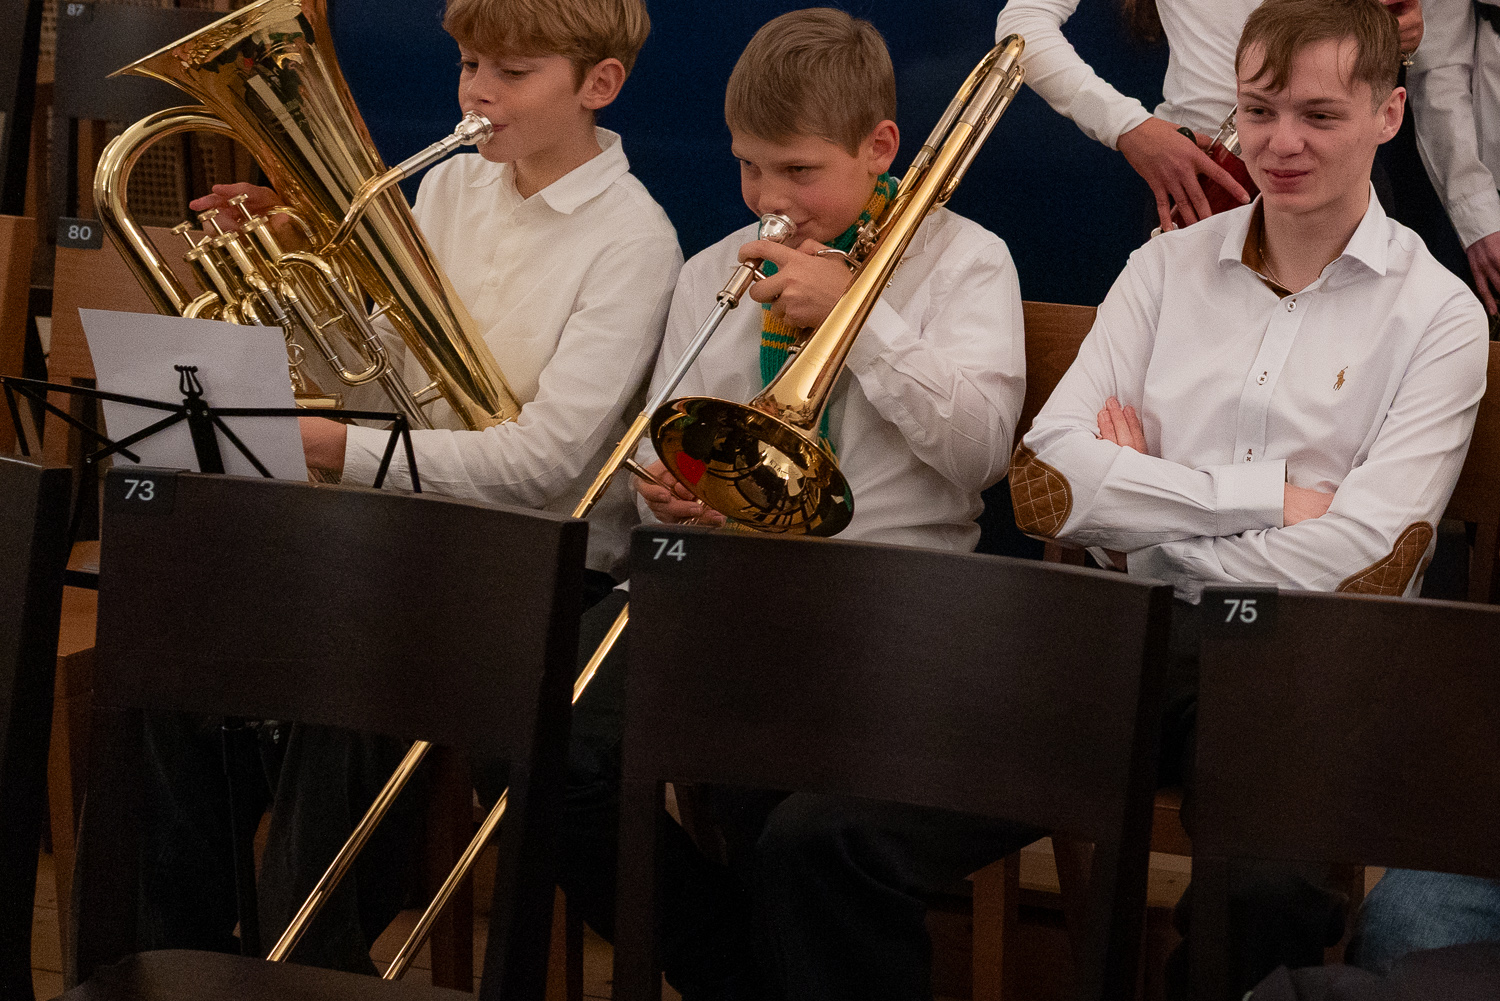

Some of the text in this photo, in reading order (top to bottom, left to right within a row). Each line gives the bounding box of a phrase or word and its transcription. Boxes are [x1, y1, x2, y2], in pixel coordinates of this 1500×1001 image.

[67, 3, 84, 16] 87
[67, 224, 91, 241] 80
[124, 479, 155, 501] 73
[652, 538, 687, 562] 74
[1223, 598, 1258, 624] 75
